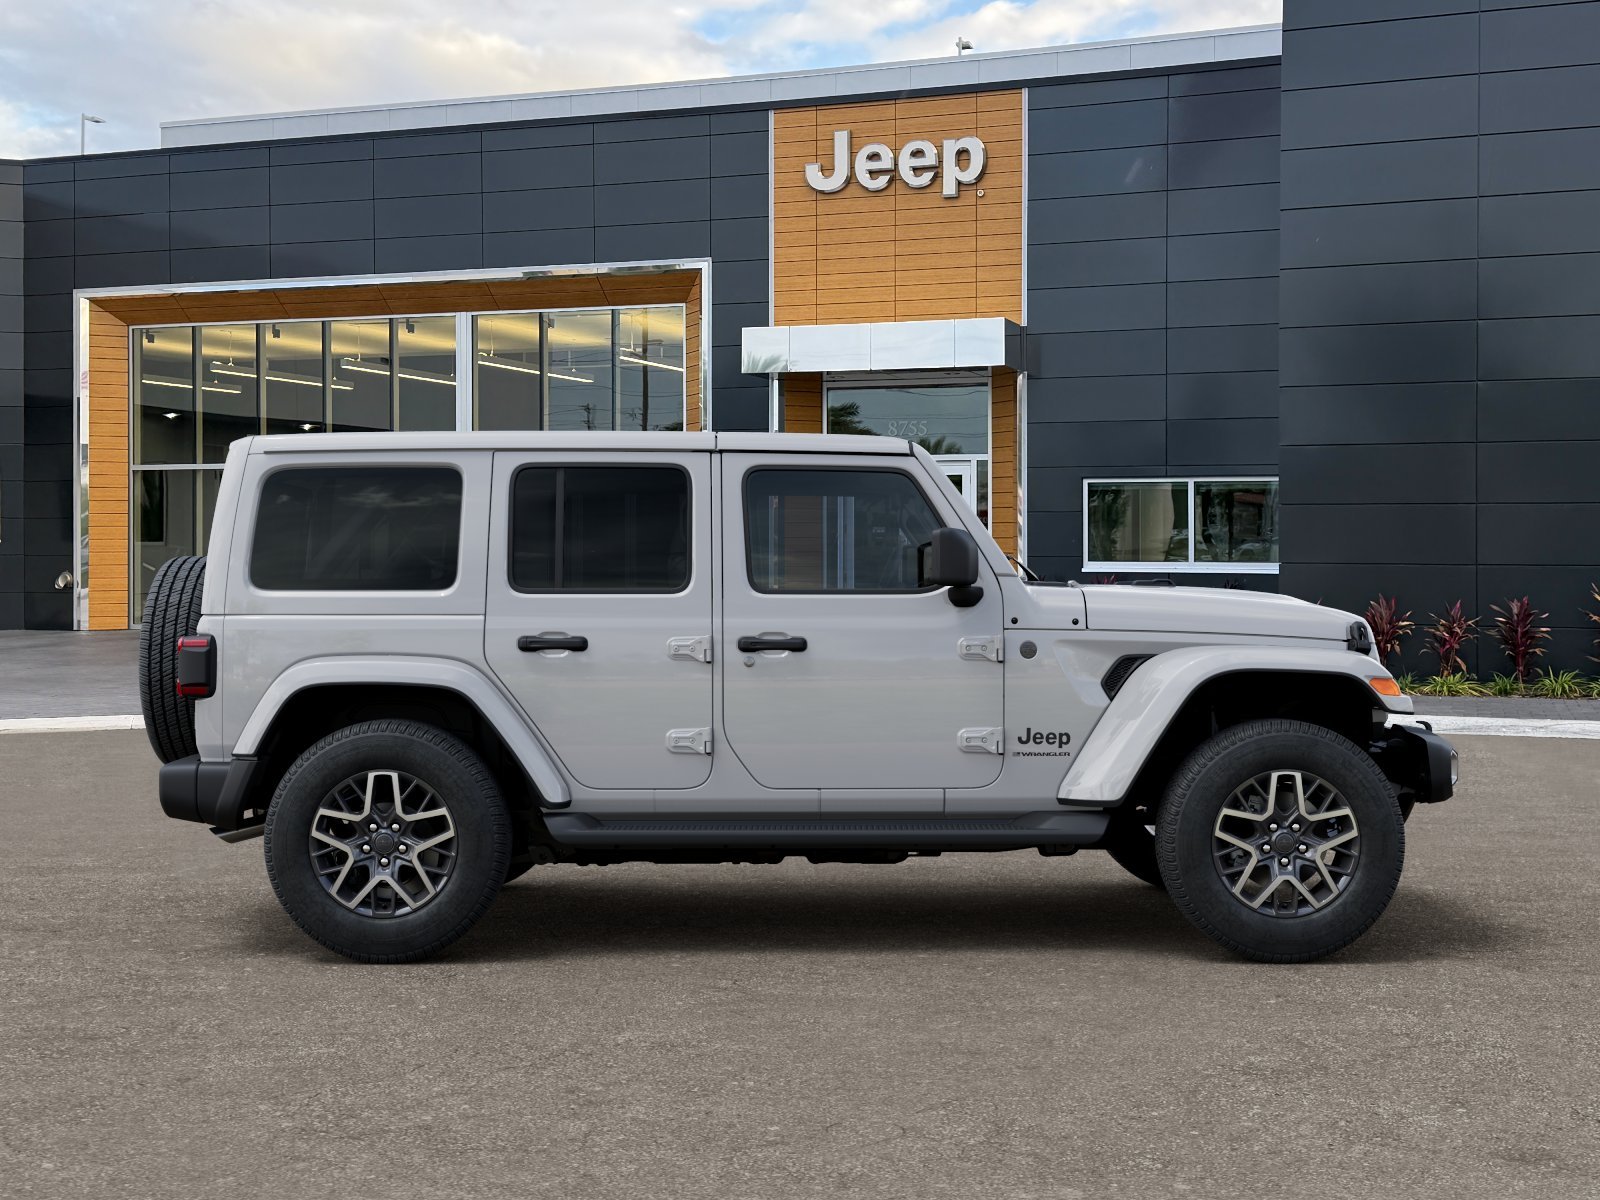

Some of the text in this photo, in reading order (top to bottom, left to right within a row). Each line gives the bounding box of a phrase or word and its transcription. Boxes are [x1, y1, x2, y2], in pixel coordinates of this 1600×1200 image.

[804, 128, 987, 198] Jeep
[888, 420, 928, 436] 8755
[1017, 727, 1071, 749] Jeep
